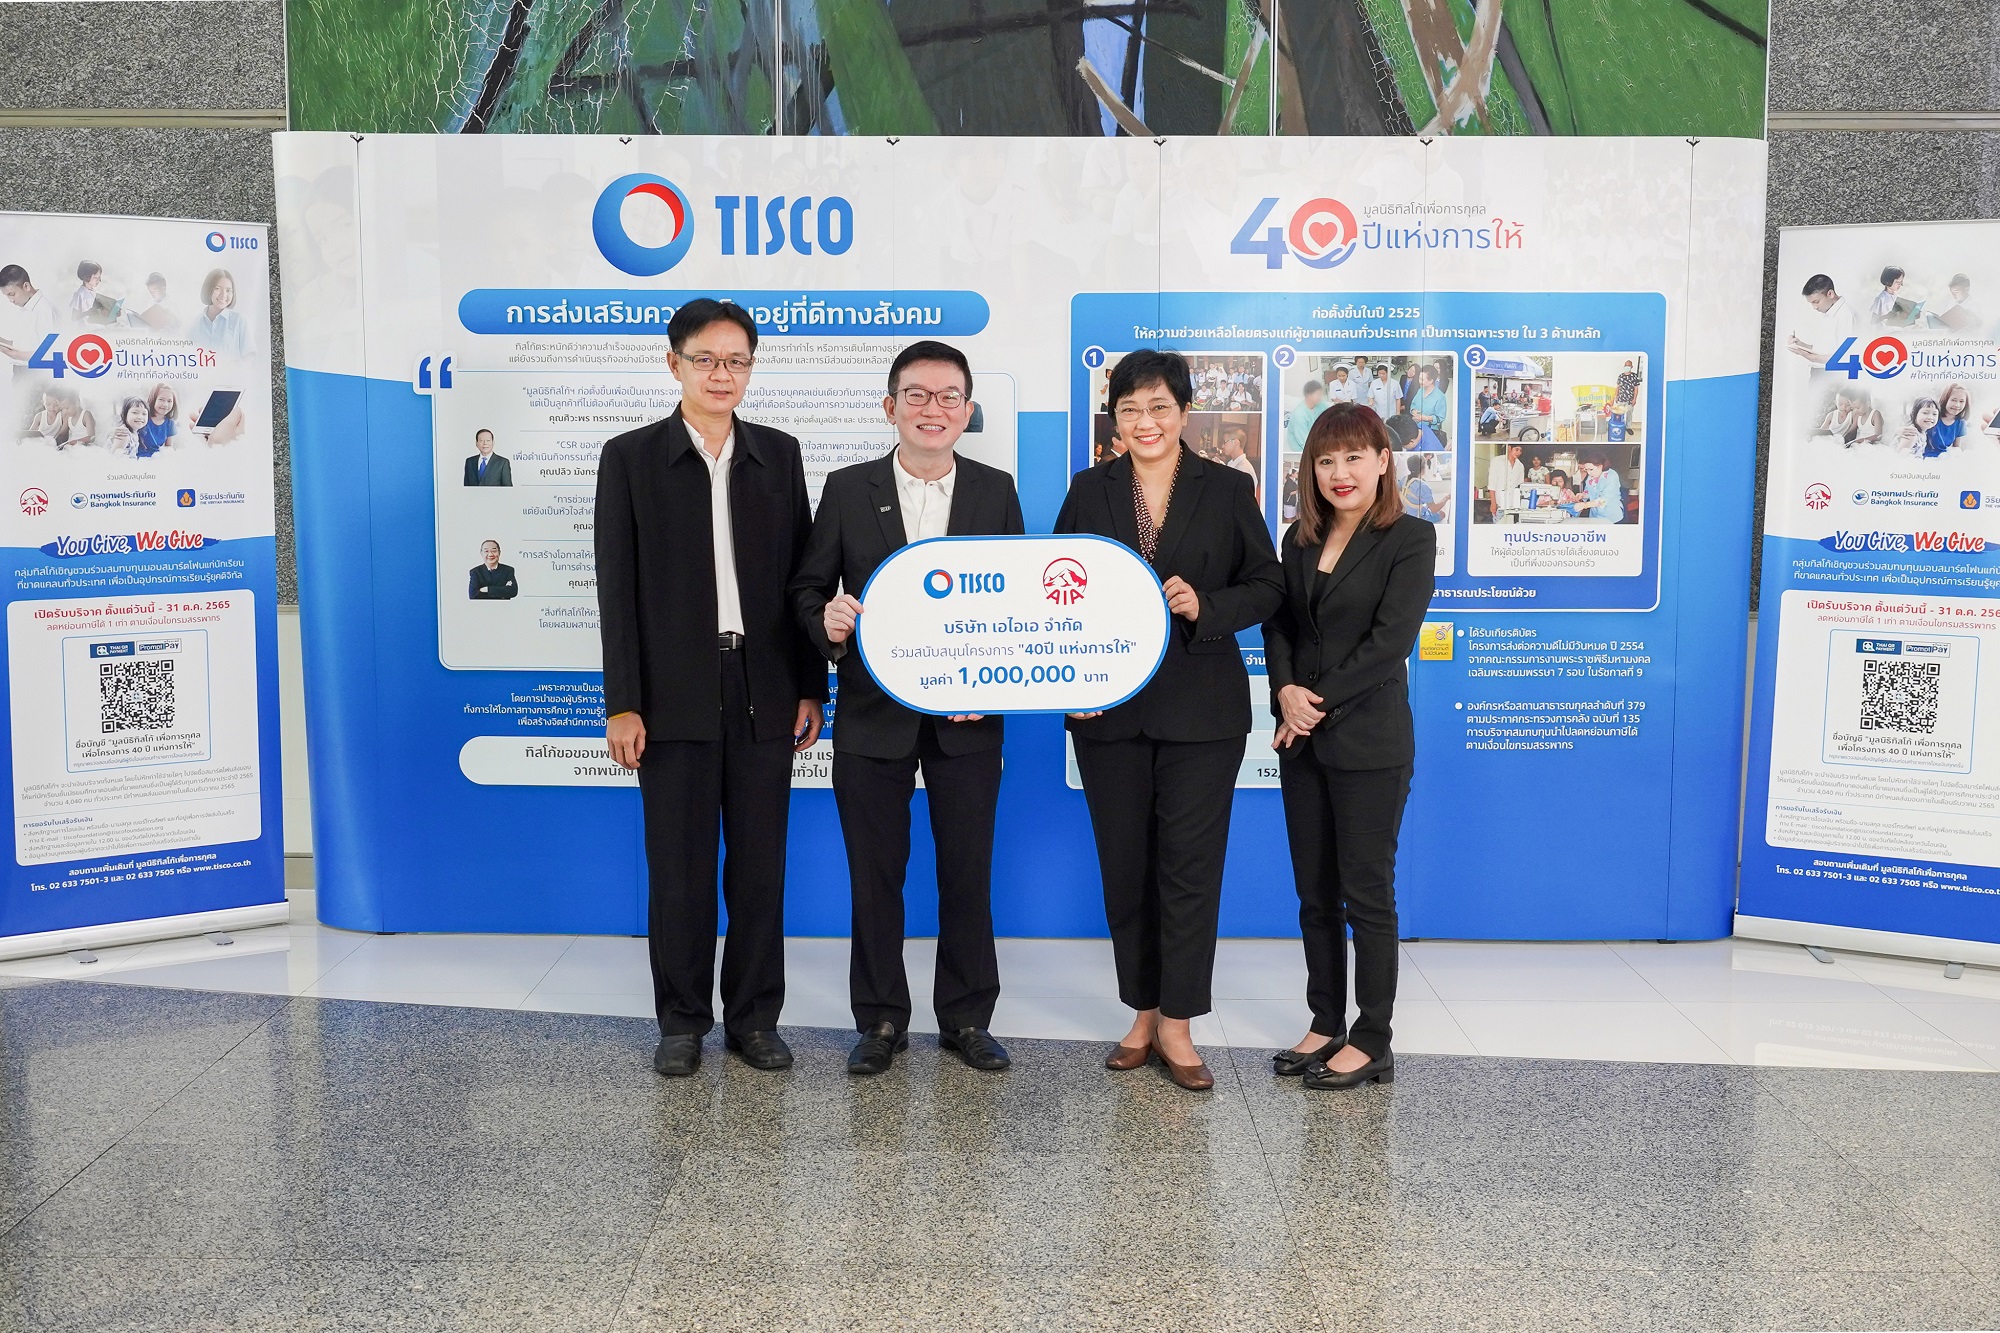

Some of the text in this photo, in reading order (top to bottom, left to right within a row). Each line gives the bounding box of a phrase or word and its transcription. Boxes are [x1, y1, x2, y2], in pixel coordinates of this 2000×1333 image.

[715, 195, 853, 256] TISCO
[1362, 218, 1524, 251] ปีแห่งการให้
[230, 236, 258, 250] TISCO
[1388, 307, 1420, 318] 2525
[1522, 325, 1537, 341] ใน
[1540, 328, 1548, 340] 3
[1551, 326, 1602, 341] ด้านหลัก
[116, 348, 216, 367] ปีแห่งการให้
[1089, 352, 1097, 365] 1
[1279, 351, 1290, 365] 2
[1471, 350, 1481, 364] 3
[90, 499, 157, 509] Bangkok Insurance
[1806, 501, 1829, 510] AIA
[1870, 498, 1939, 507] Bangkok Insurance
[23, 507, 47, 516] AIA
[57, 530, 203, 555] You Give, We Give
[1504, 530, 1606, 546] ทุนประกอบอาชีพ
[1835, 531, 1985, 552] You Give, We Give
[959, 572, 1005, 594] TISCO
[1046, 589, 1084, 606] AIA
[34, 606, 102, 619] เปิดรับบริจาค
[166, 603, 178, 612] 31
[183, 603, 202, 613] ต.ค.
[205, 600, 230, 610] 2565
[1807, 599, 1872, 612] เปิดรับบริจาค
[1938, 606, 1951, 616] 31
[1956, 608, 1977, 617] ต.ค.
[1981, 608, 2000, 618] 256
[944, 617, 1083, 635] บริษัท เอไอเอ จำกัด
[891, 643, 1014, 661] ร่วมสนับสนุนโครงการ
[1611, 641, 1618, 651] ปี
[1620, 641, 1644, 650] 2554
[920, 664, 1109, 690] มูลค่า 1,000,000 บาท
[1558, 668, 1563, 677] 7
[1566, 669, 1585, 677] รอบ
[1637, 668, 1643, 677] 9
[1627, 701, 1646, 711] 379
[1623, 714, 1640, 723] 135
[132, 746, 142, 754] 40
[1257, 768, 1281, 778] 152,
[49, 882, 60, 890] 02
[62, 879, 78, 888] 633
[80, 876, 109, 887] 7501-3
[126, 873, 136, 882] 02
[138, 871, 153, 880] 633
[154, 867, 175, 878] 7505
[193, 859, 251, 874] www.tisco.co.th
[1793, 868, 1803, 876] 02
[1806, 869, 1821, 877] 633
[1823, 871, 1852, 881] 7501-3
[1869, 875, 1880, 883] 02
[1882, 877, 1897, 885] 633
[1899, 879, 1920, 887] 7505
